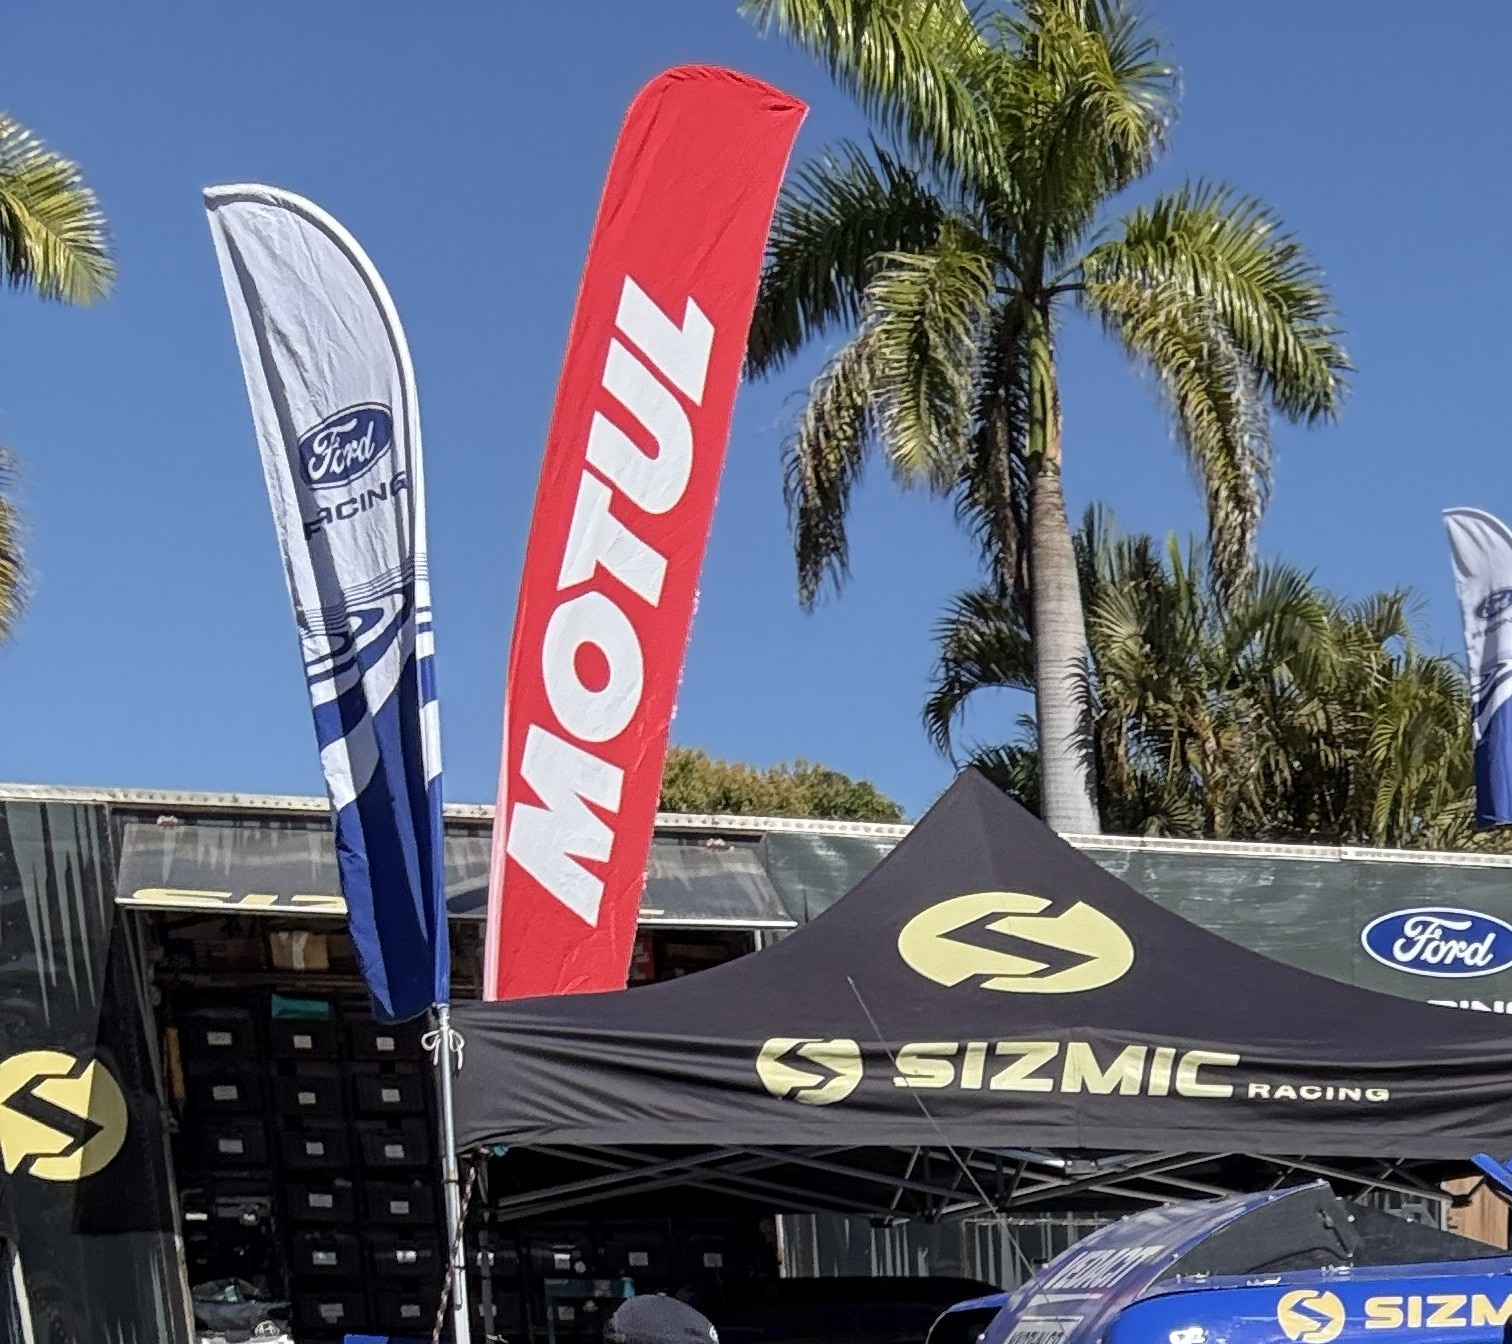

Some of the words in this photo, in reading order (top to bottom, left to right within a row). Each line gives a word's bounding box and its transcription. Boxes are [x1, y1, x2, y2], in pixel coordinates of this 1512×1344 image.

[308, 418, 375, 481] Ford
[507, 274, 715, 928] MOTUL
[1392, 915, 1497, 967] Ford
[893, 1041, 1240, 1098] SIZMIC
[1248, 1082, 1390, 1102] RACING
